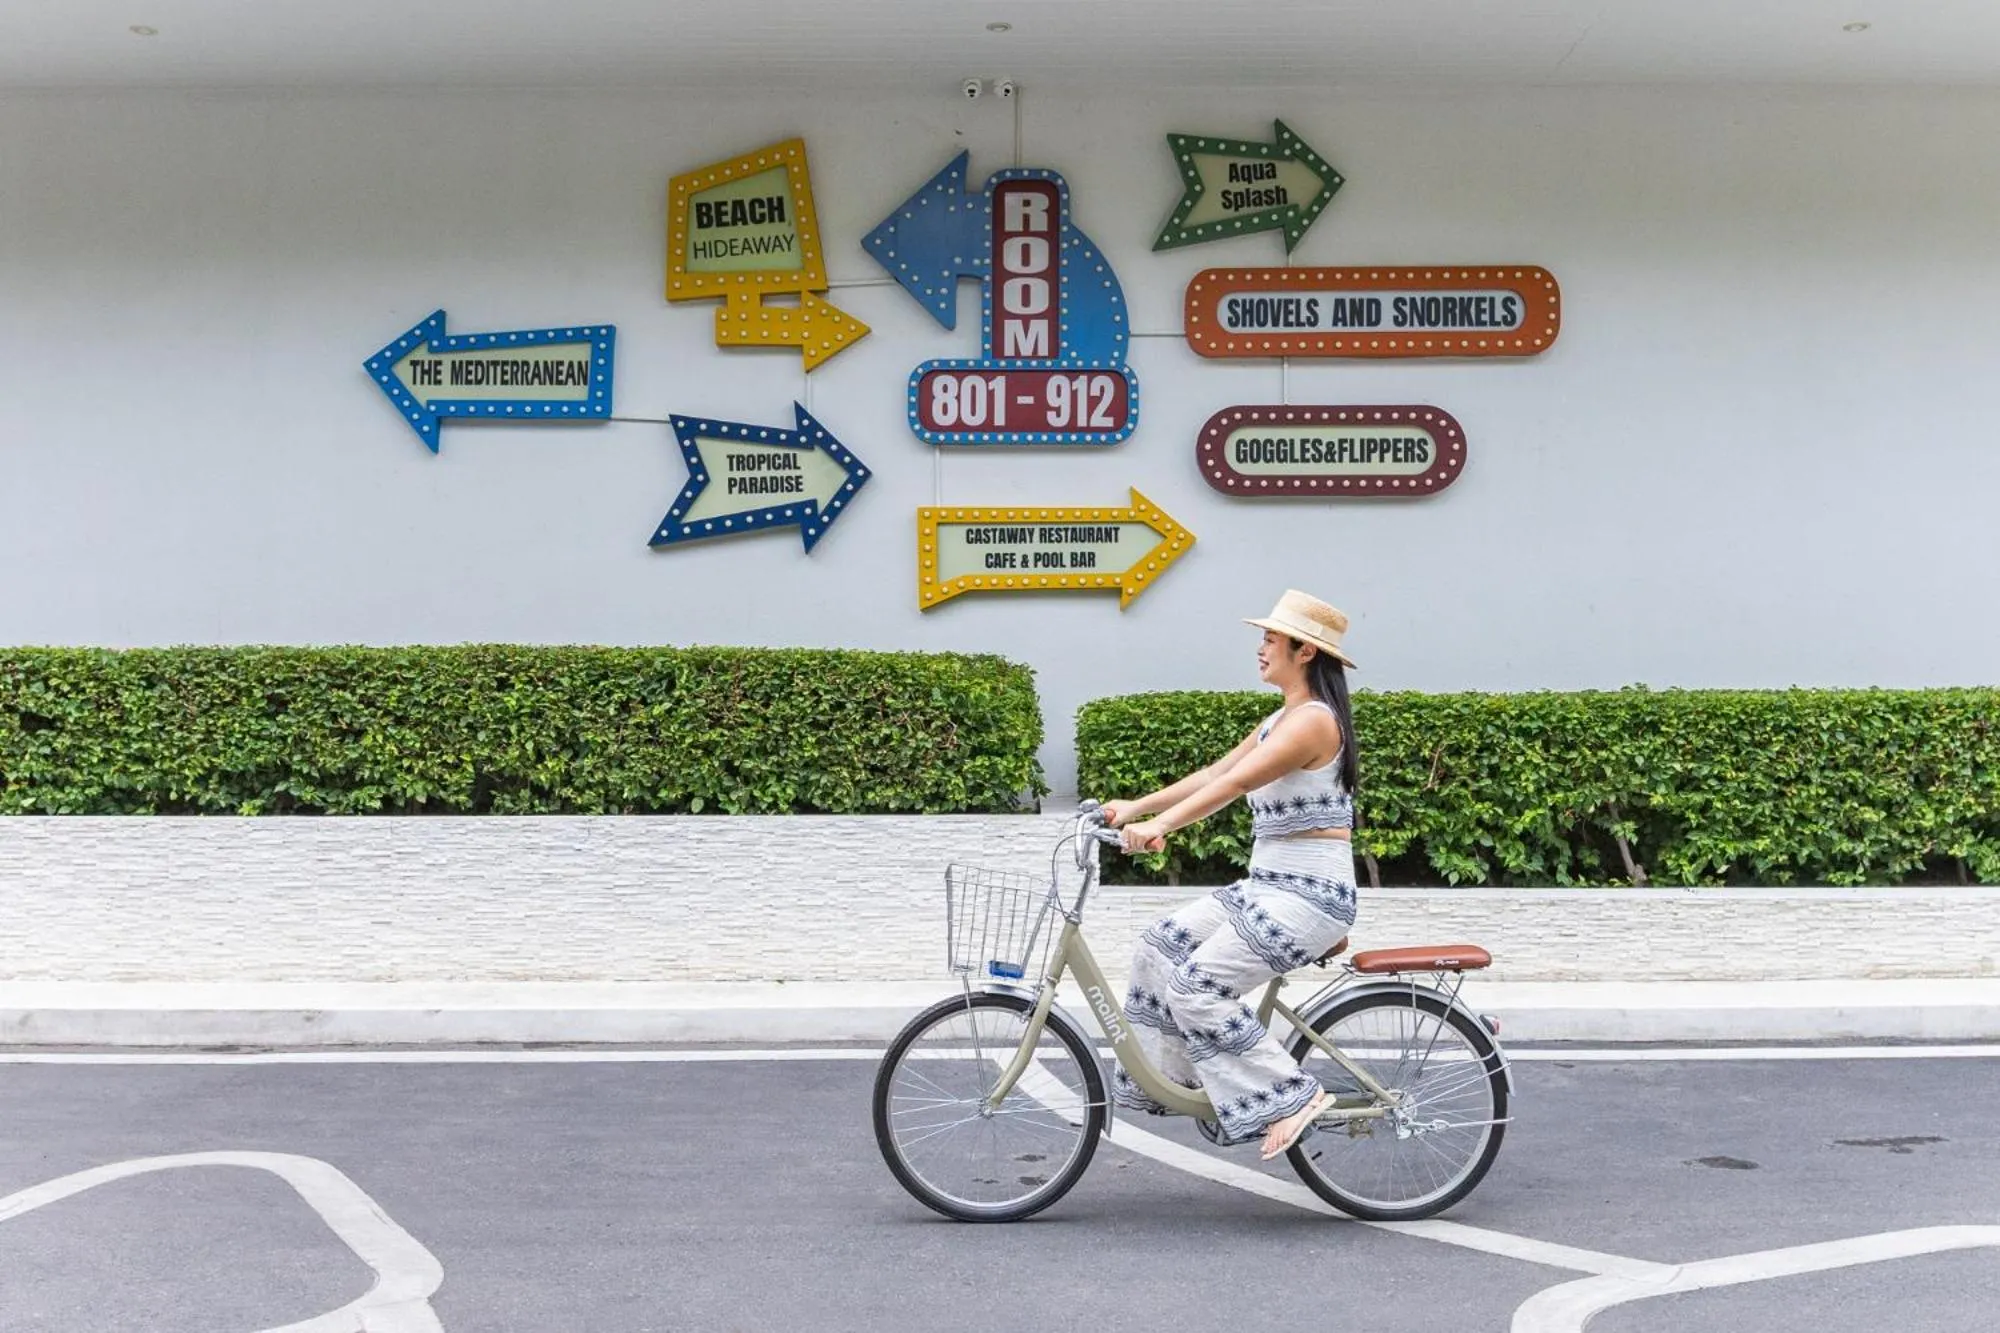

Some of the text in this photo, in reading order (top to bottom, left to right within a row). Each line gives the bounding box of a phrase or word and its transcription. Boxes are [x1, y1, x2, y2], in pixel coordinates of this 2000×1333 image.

[1228, 161, 1277, 185] Aqua
[1221, 186, 1288, 212] Splash
[695, 196, 786, 230] BEACH
[693, 234, 795, 260] HIDEAWAY
[1003, 191, 1050, 357] ROOM
[1227, 296, 1518, 328] SHOVELS AND SNORKELS
[409, 359, 589, 386] THE MEDITERRANEAN
[931, 375, 1007, 427] 801
[1046, 375, 1115, 428] 912
[726, 453, 801, 473] TROPICAL
[1235, 437, 1429, 465] GOGGLES&FLIPPERS
[727, 475, 803, 495] PARADISE
[965, 526, 1120, 544] CASTAWAY RESTAURANT
[985, 552, 1096, 569] CAFE & POOL BAR
